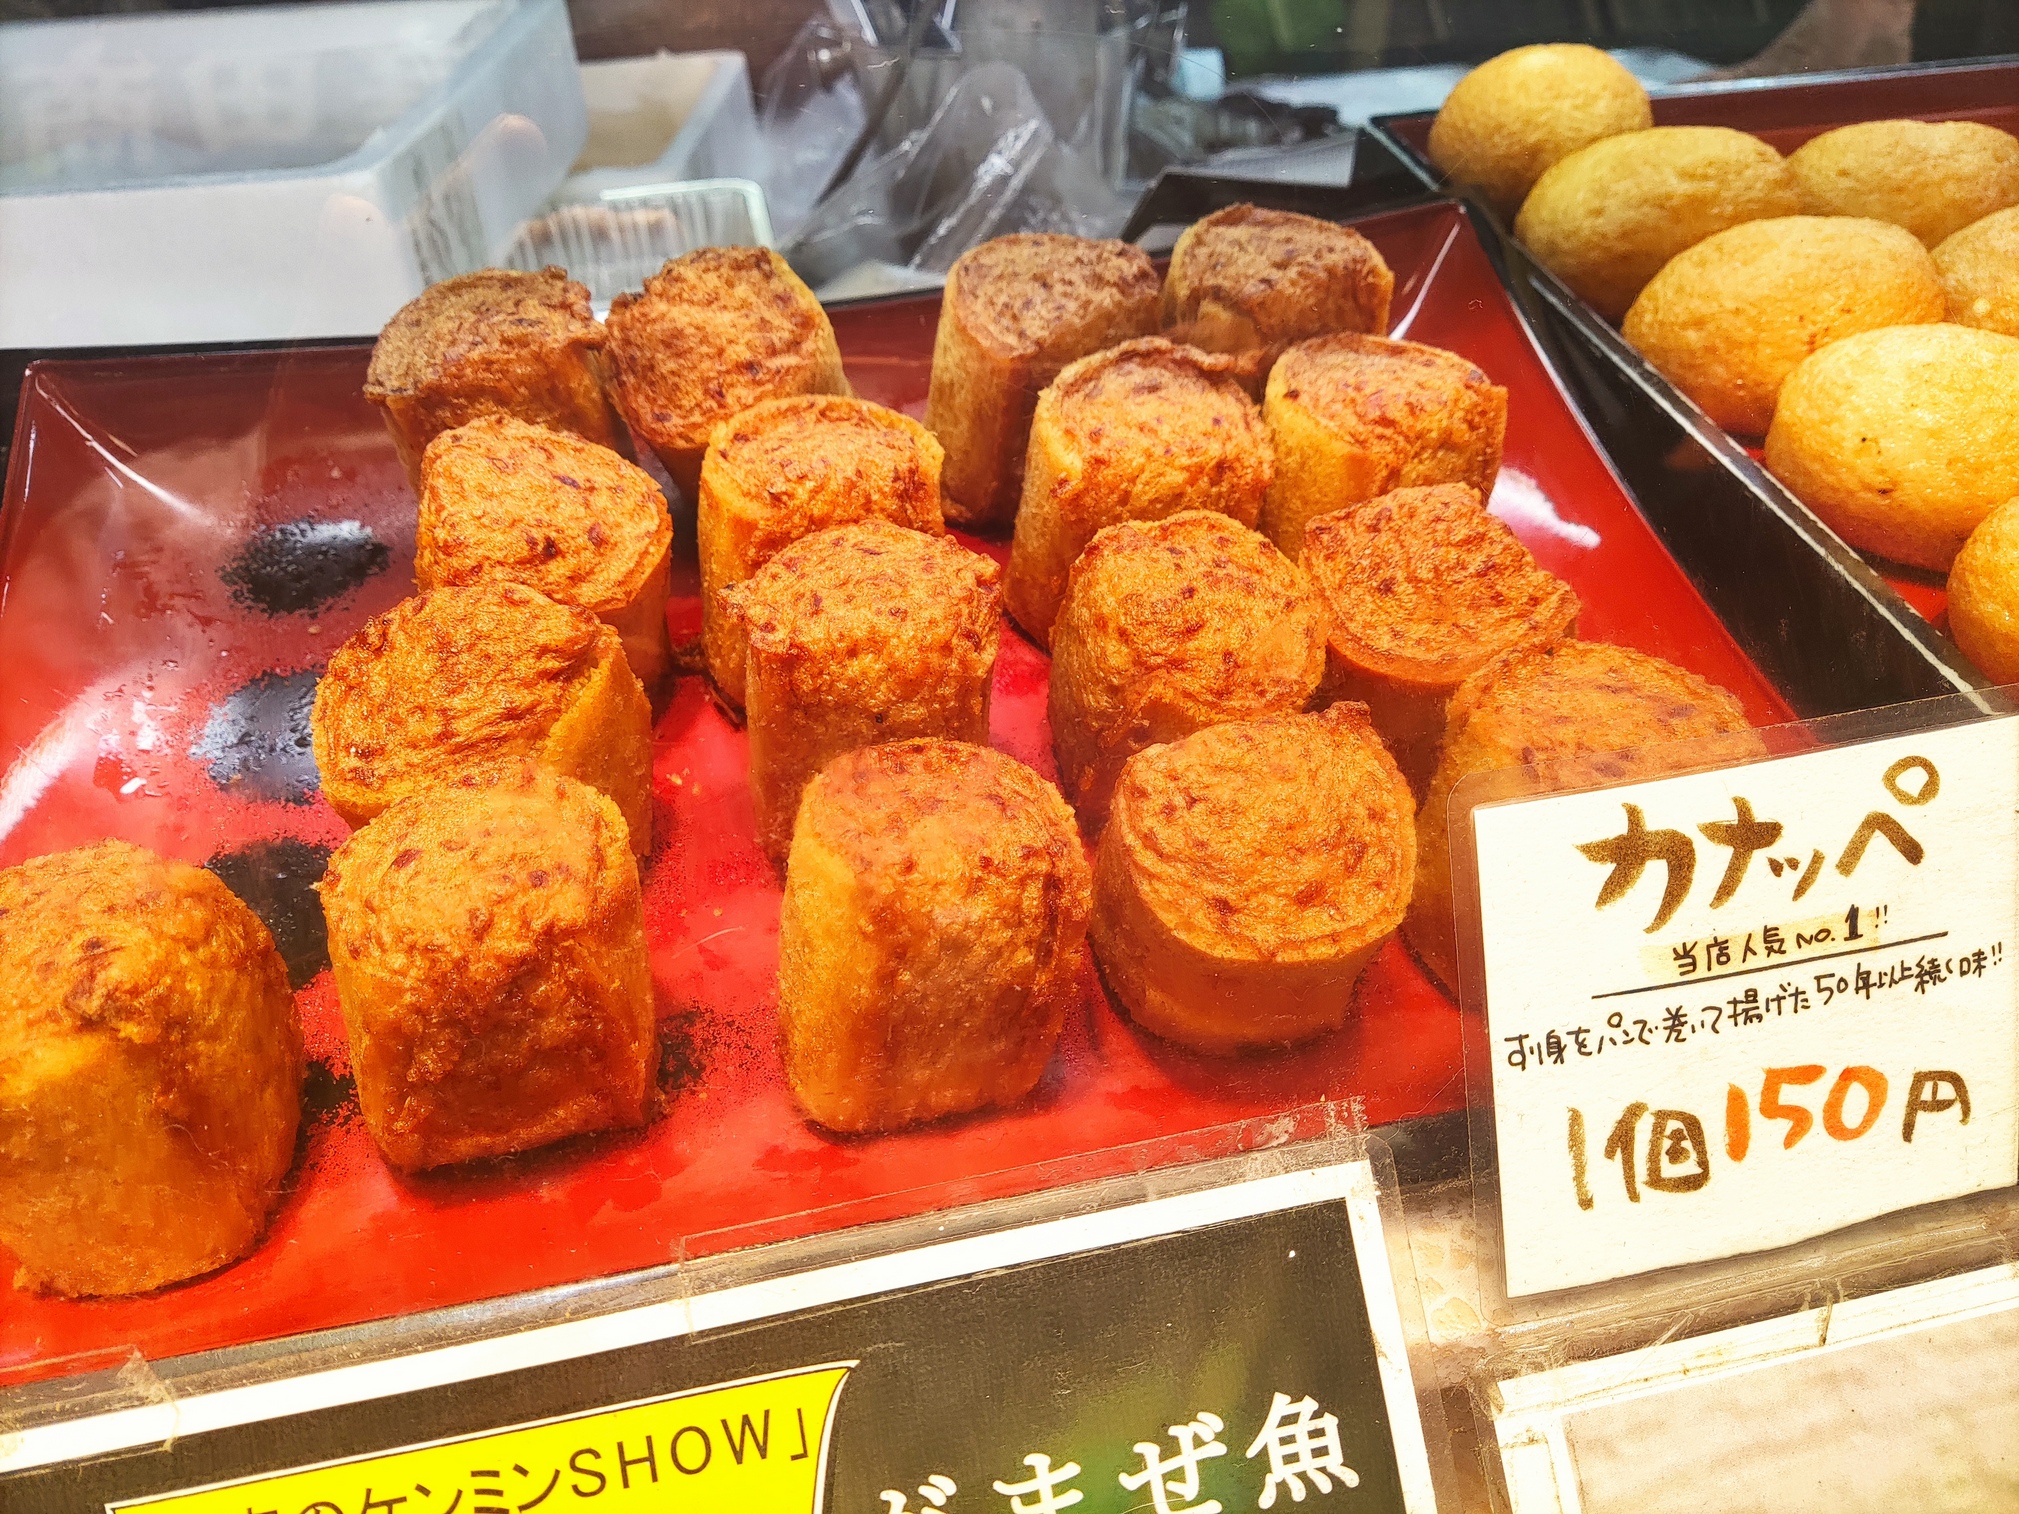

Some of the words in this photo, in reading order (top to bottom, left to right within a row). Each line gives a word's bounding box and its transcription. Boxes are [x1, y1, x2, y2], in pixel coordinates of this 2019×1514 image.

[1572, 755, 1941, 934] カナッペ
[1567, 1064, 1972, 1212] 1個150円
